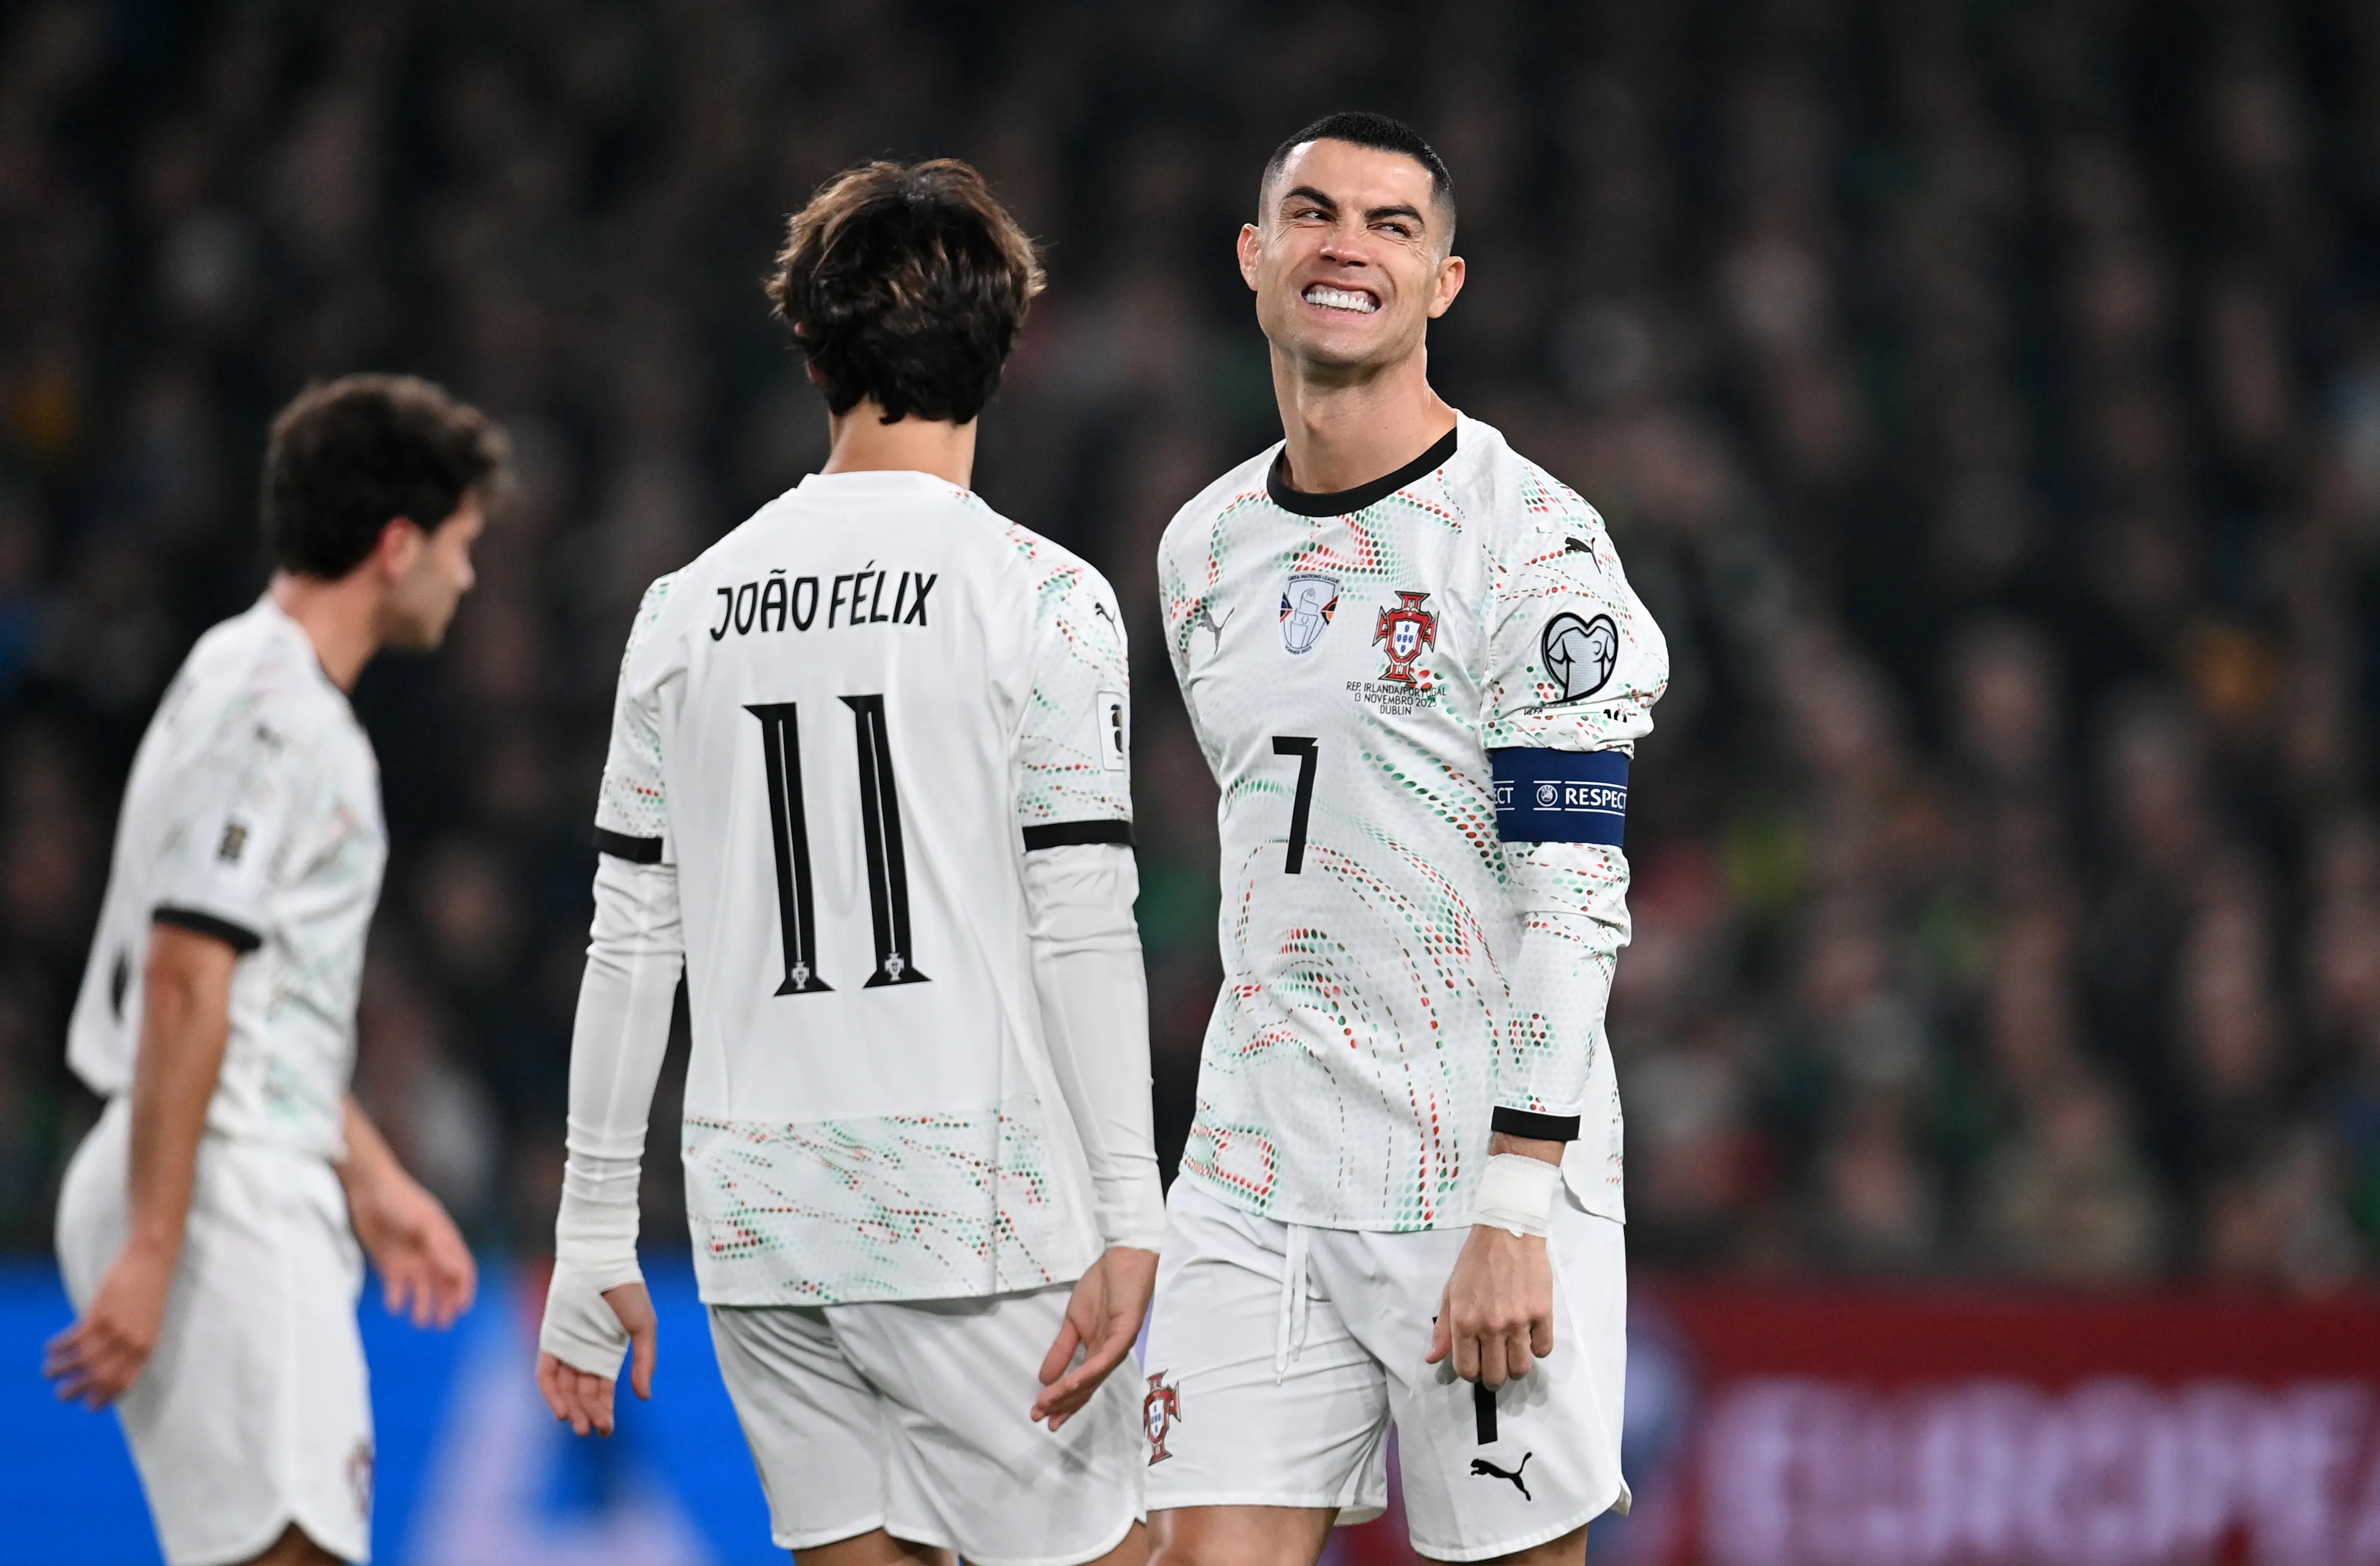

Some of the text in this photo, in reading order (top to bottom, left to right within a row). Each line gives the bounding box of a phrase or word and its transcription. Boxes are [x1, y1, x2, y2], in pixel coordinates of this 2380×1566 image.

[710, 559, 938, 642] JOÃO FÉLIX
[1346, 681, 1446, 697] REP. IRLANDA/PORTUGAL
[1355, 693, 1437, 707] 13 NOVEMBRO 2025
[1380, 705, 1412, 715] DUBLIN
[1272, 736, 1319, 874] 7
[1565, 787, 1627, 810] RESPECT
[741, 693, 933, 998] 11
